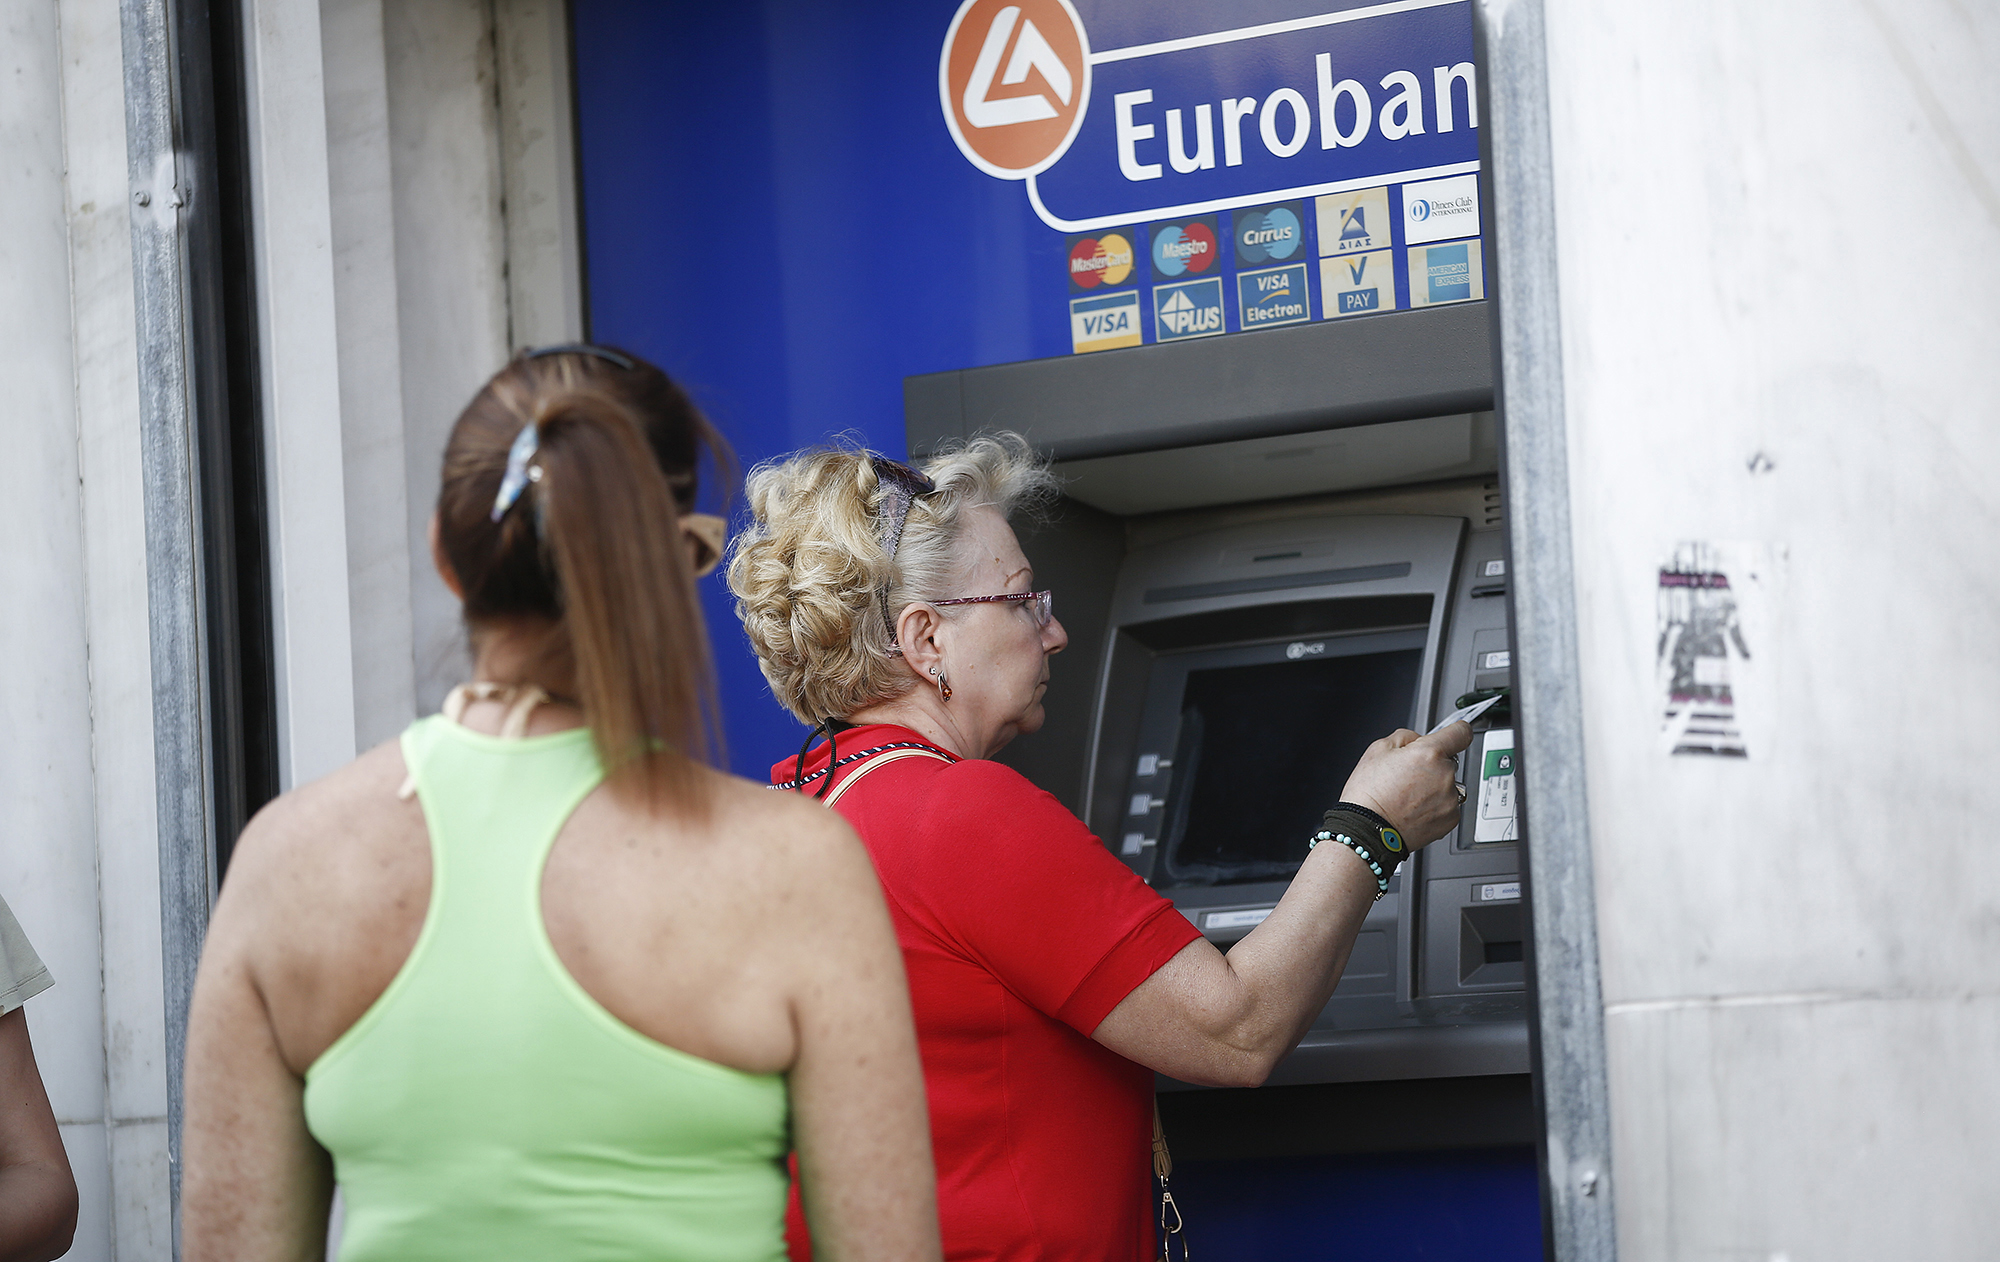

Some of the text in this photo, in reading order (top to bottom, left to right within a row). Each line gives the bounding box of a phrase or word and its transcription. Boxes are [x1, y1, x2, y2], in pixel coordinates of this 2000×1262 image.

[1114, 52, 1478, 182] Euroban
[1431, 196, 1473, 211] Diners Club
[1432, 207, 1473, 217] INTERNATIONAL
[1243, 226, 1292, 246] Cirrus
[1162, 239, 1208, 259] Maestro
[1071, 248, 1131, 273] MasterCard
[1428, 263, 1467, 276] AMERICAN
[1257, 273, 1290, 291] VISA
[1435, 273, 1470, 287] EXPRESS
[1346, 292, 1371, 309] PAY
[1176, 306, 1221, 334] PLUS
[1246, 303, 1302, 322] Electron
[1083, 312, 1129, 335] VISA
